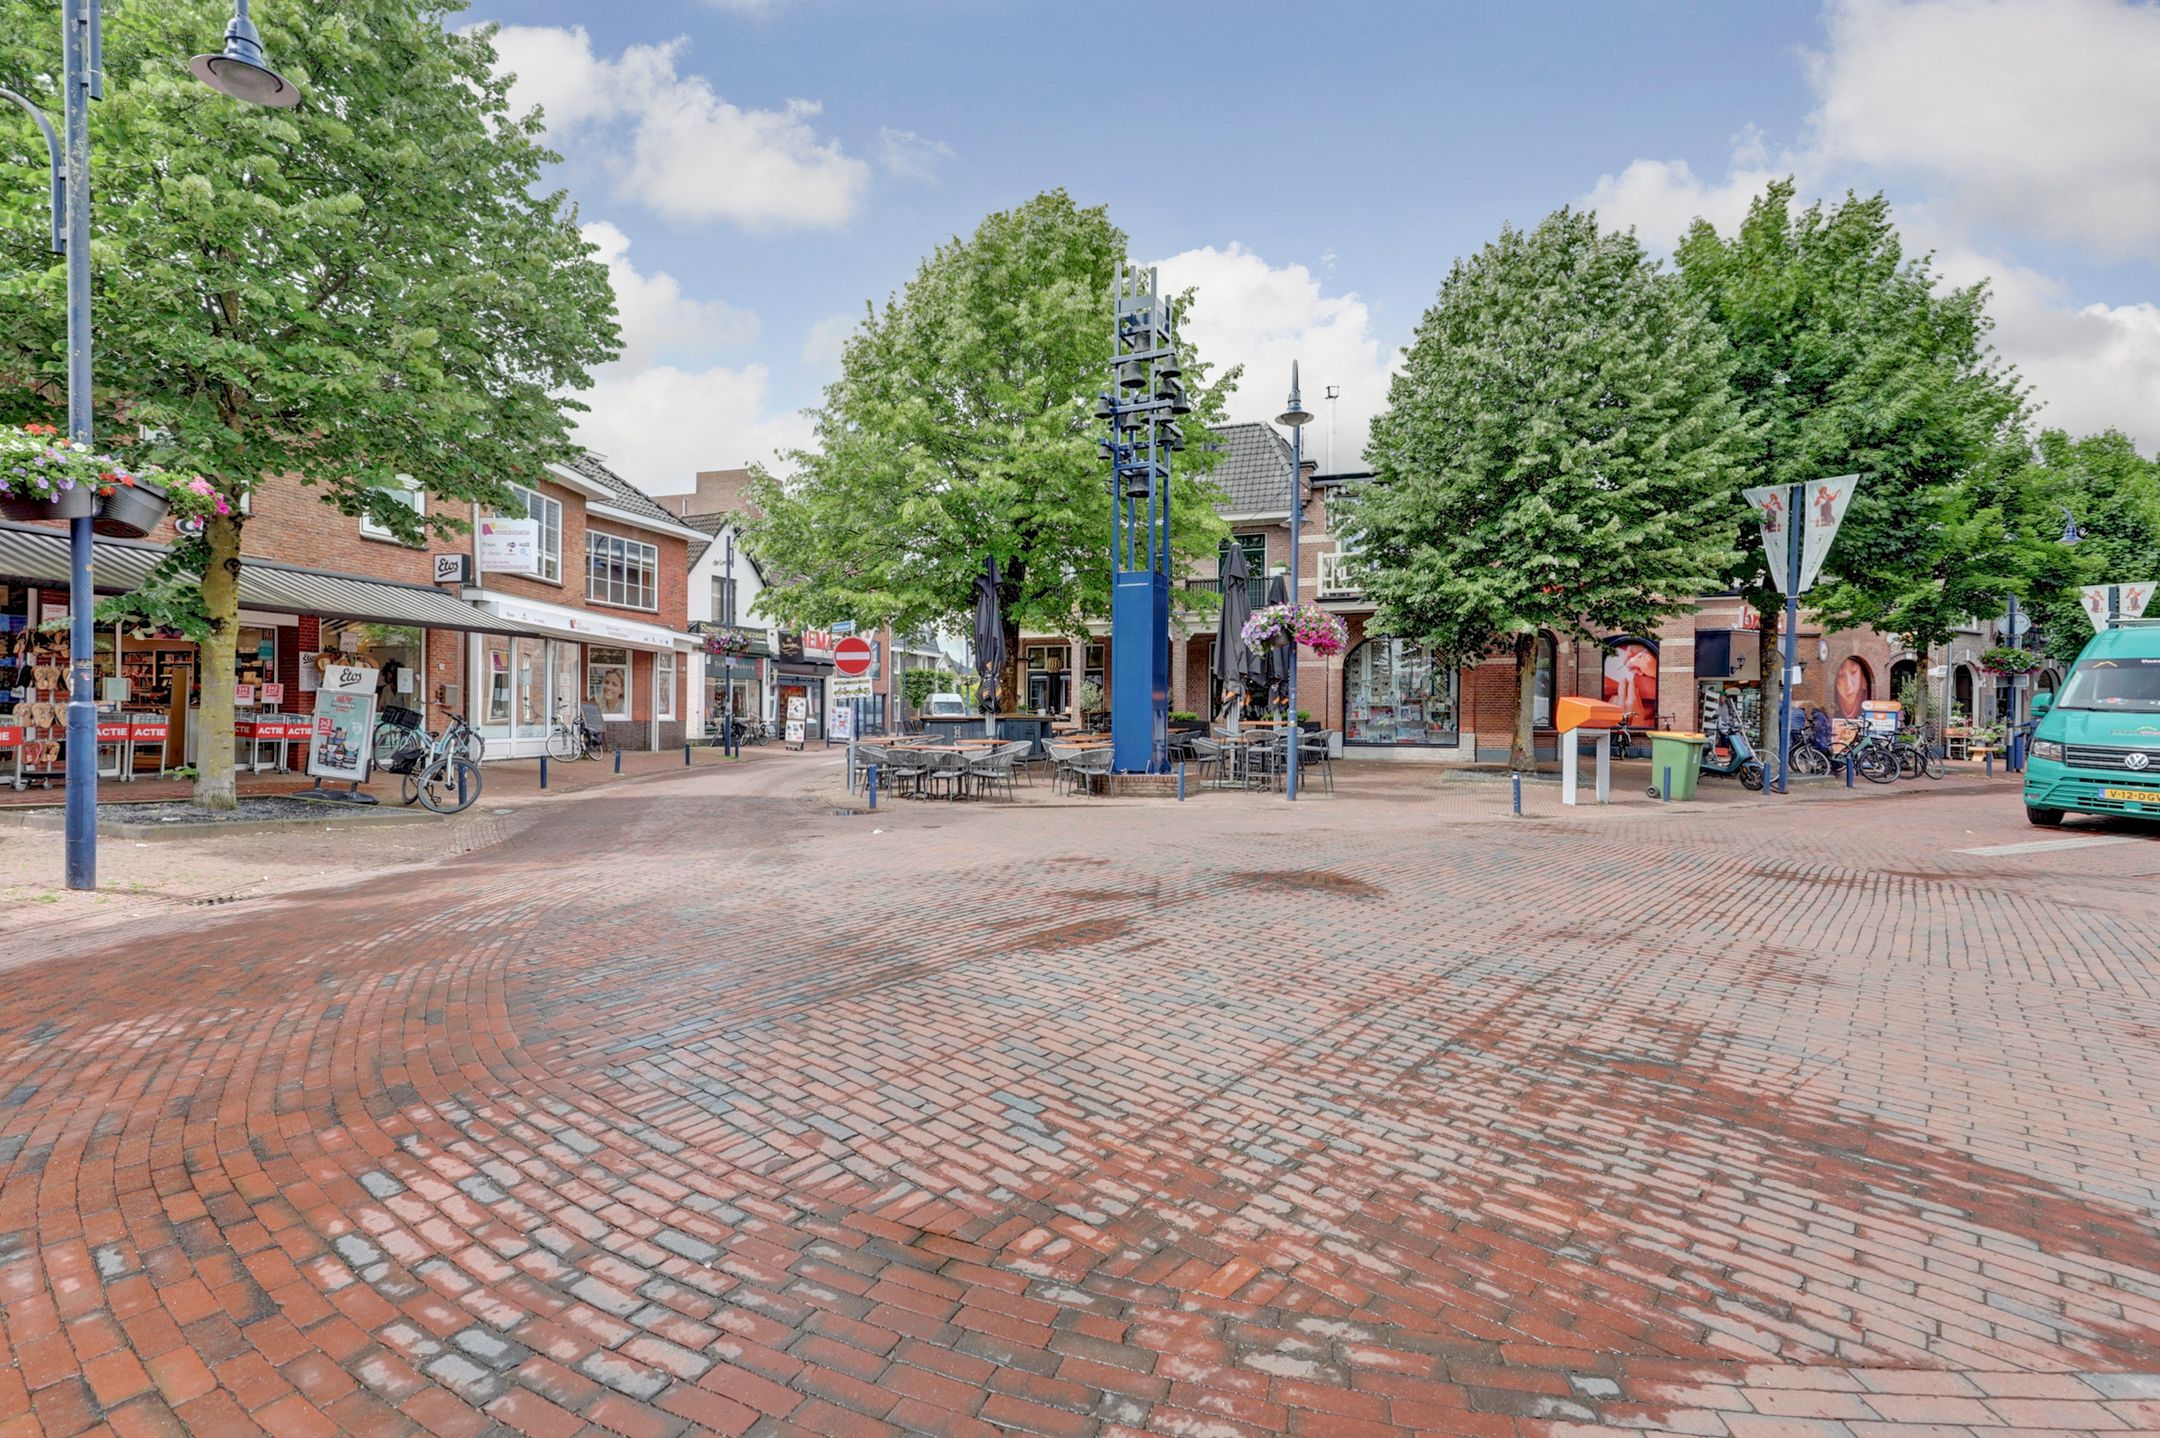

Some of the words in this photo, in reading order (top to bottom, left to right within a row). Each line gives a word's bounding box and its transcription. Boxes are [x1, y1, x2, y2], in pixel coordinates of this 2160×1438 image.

[438, 557, 459, 574] Etos
[339, 668, 363, 684] Etos
[134, 728, 167, 737] ACTIE
[235, 725, 250, 733] CTIE
[257, 726, 284, 735] ACTIE
